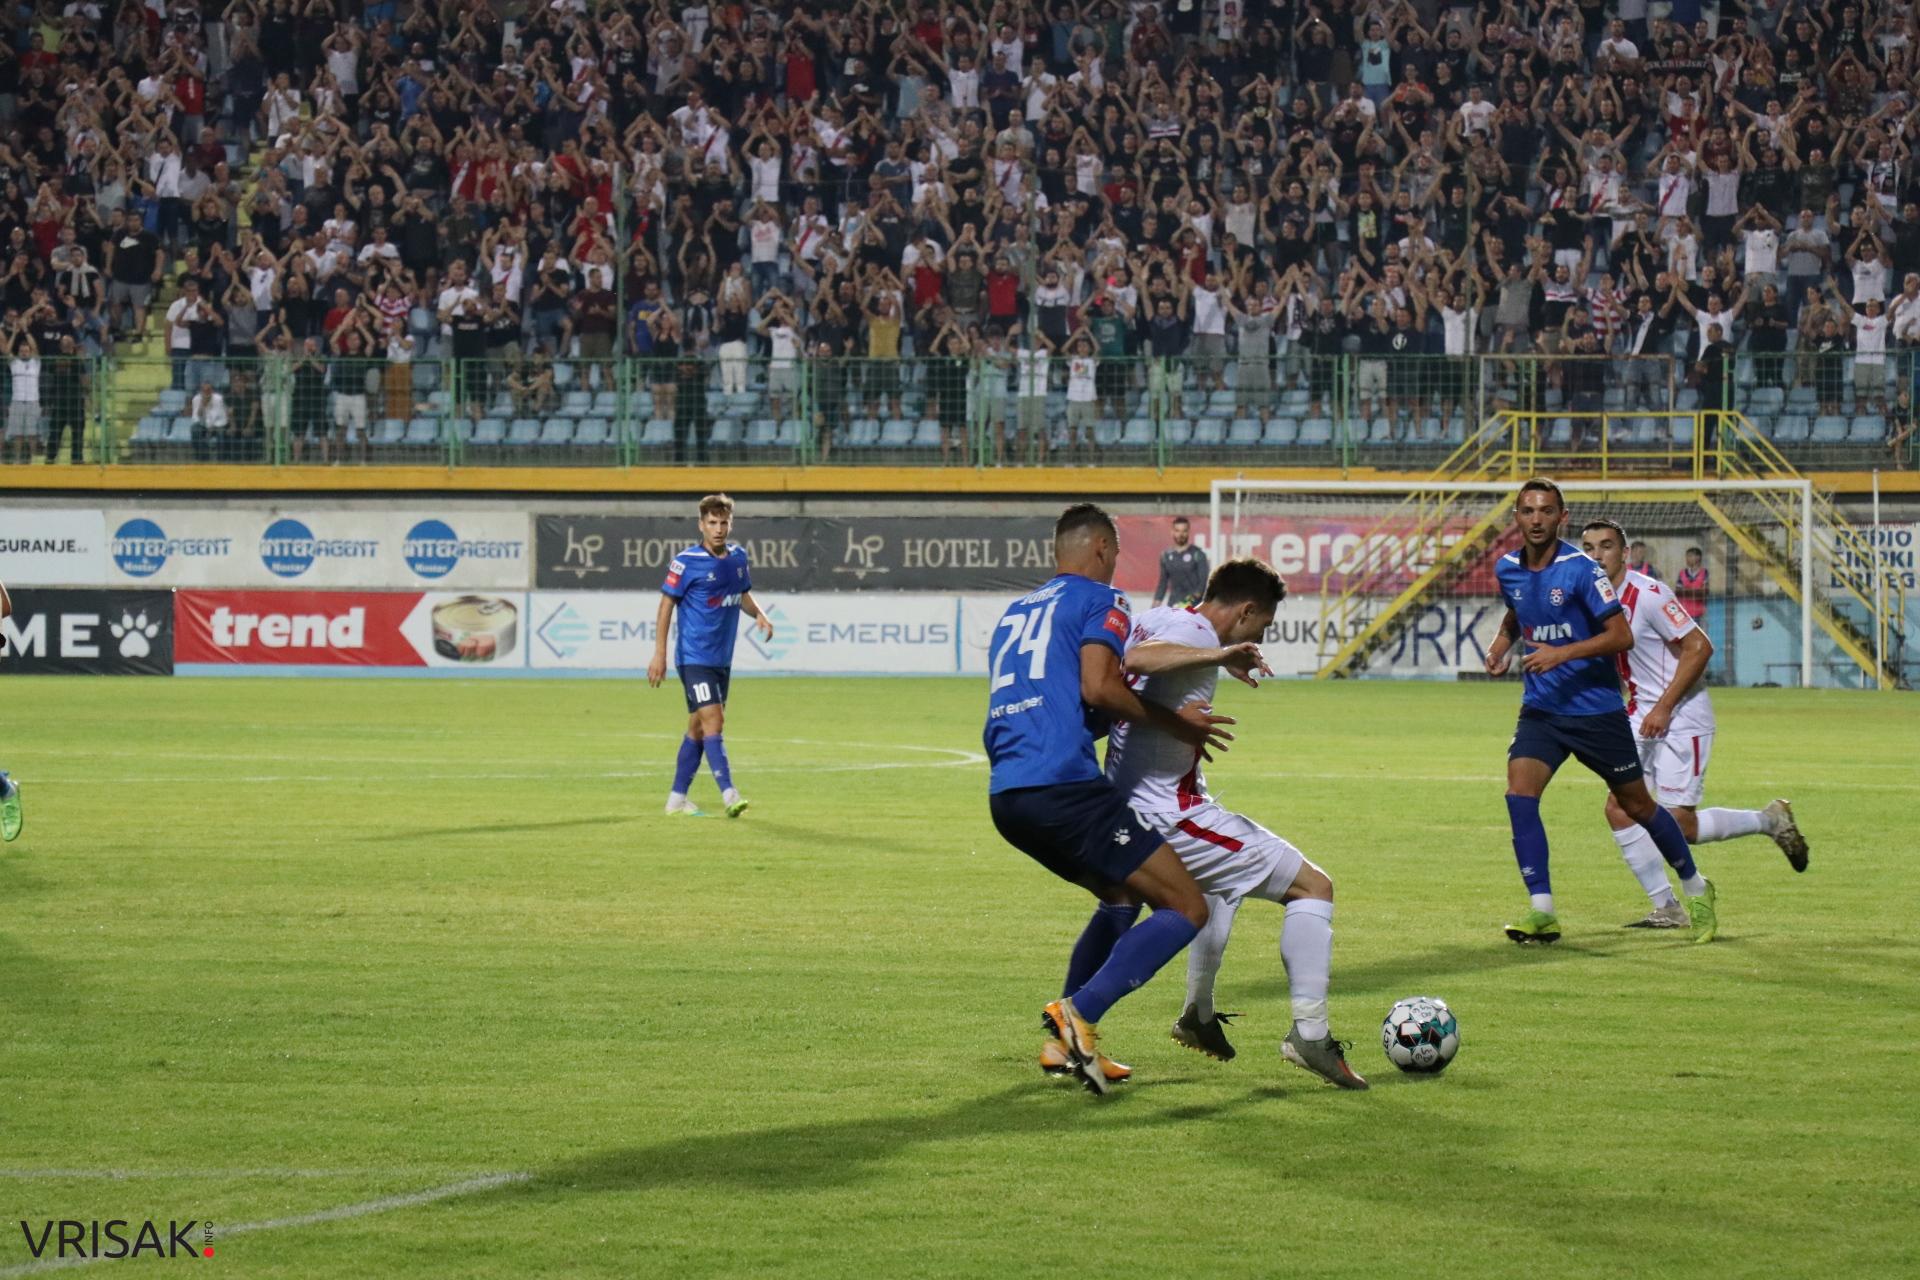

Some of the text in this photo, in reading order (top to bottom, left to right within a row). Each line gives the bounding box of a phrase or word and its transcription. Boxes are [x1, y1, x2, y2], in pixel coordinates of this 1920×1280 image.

[730, 539, 799, 567] ARK
[903, 539, 999, 568] HOTEL
[210, 606, 365, 648] trend
[808, 624, 949, 643] EMERUS
[990, 601, 1057, 694] 24
[693, 682, 711, 703] 10
